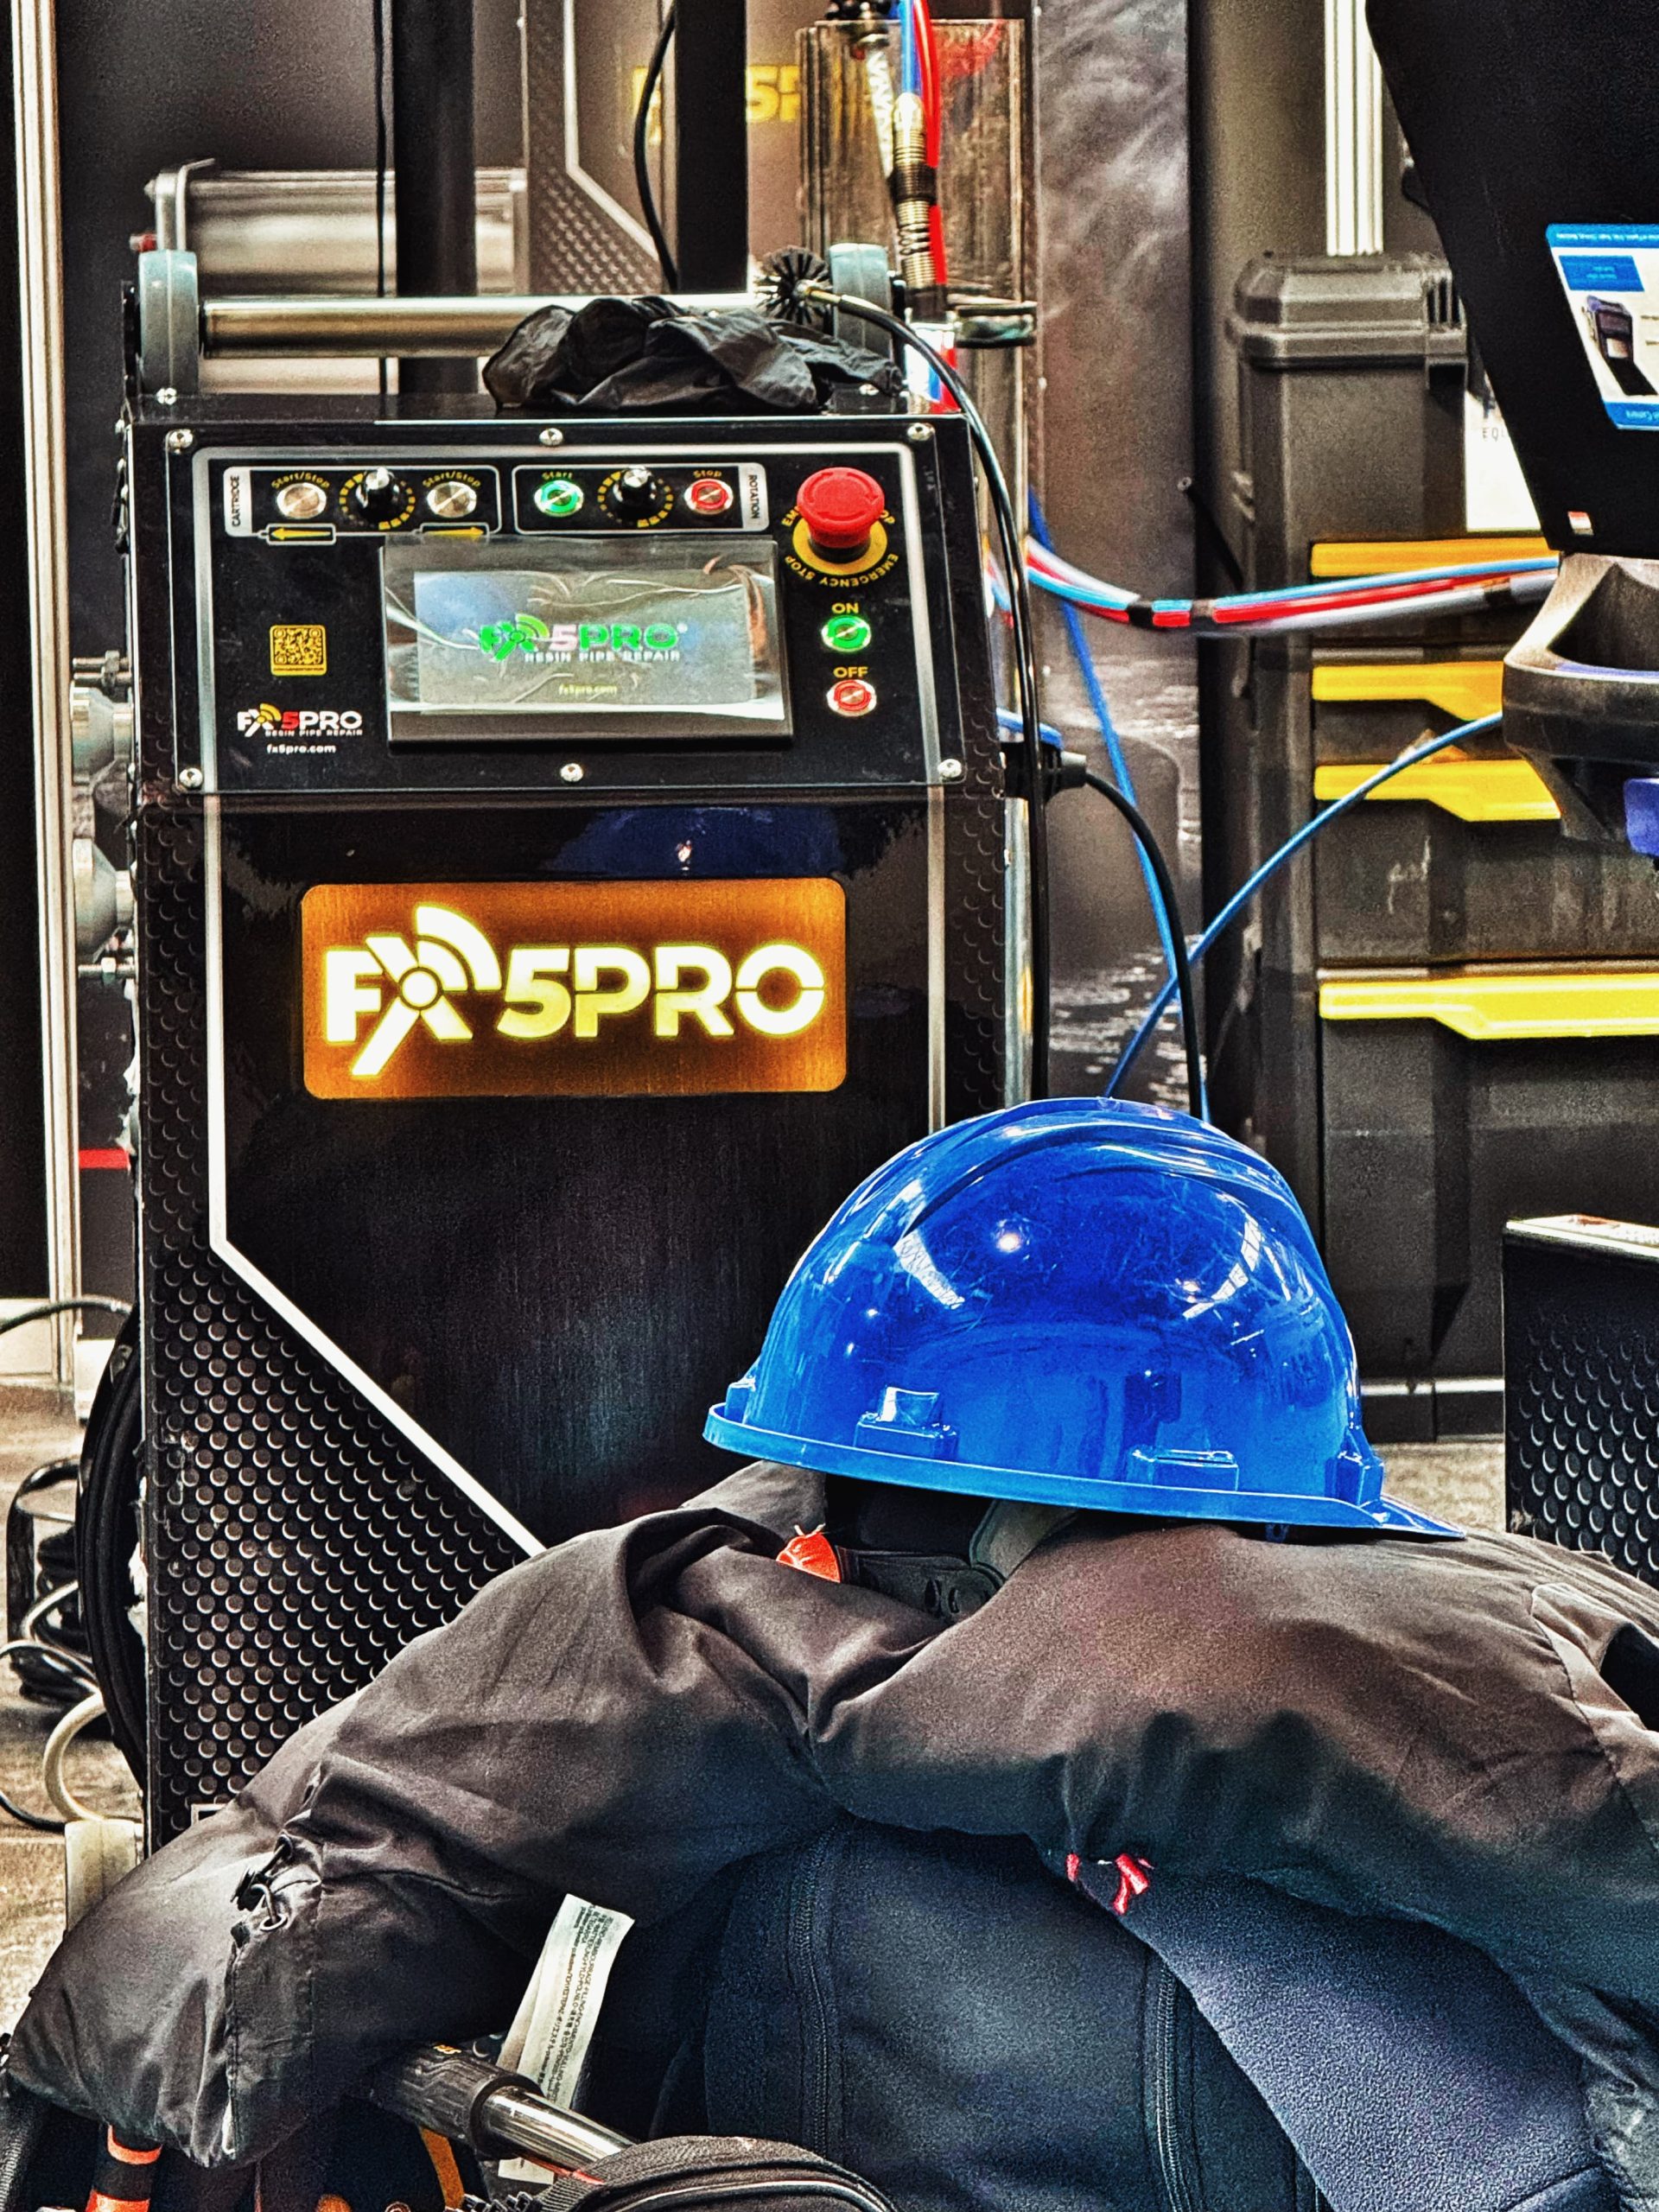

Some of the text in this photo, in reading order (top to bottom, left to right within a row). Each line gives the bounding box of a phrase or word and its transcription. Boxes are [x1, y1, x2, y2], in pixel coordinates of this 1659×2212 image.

[270, 471, 331, 489] Start/Stop
[422, 471, 482, 488] Start/Stop
[542, 470, 574, 480] Start
[693, 469, 722, 479] Stop
[747, 474, 761, 519] ROTATION
[784, 553, 899, 588] EMERGENCY STOP
[831, 602, 859, 614] ON
[524, 650, 681, 664] RESIN PIPE REPAIR
[833, 666, 869, 678] OFF
[237, 702, 363, 738] FX5PRO
[266, 743, 337, 755] fx5pro.com
[324, 905, 826, 1077] FX5PRO
